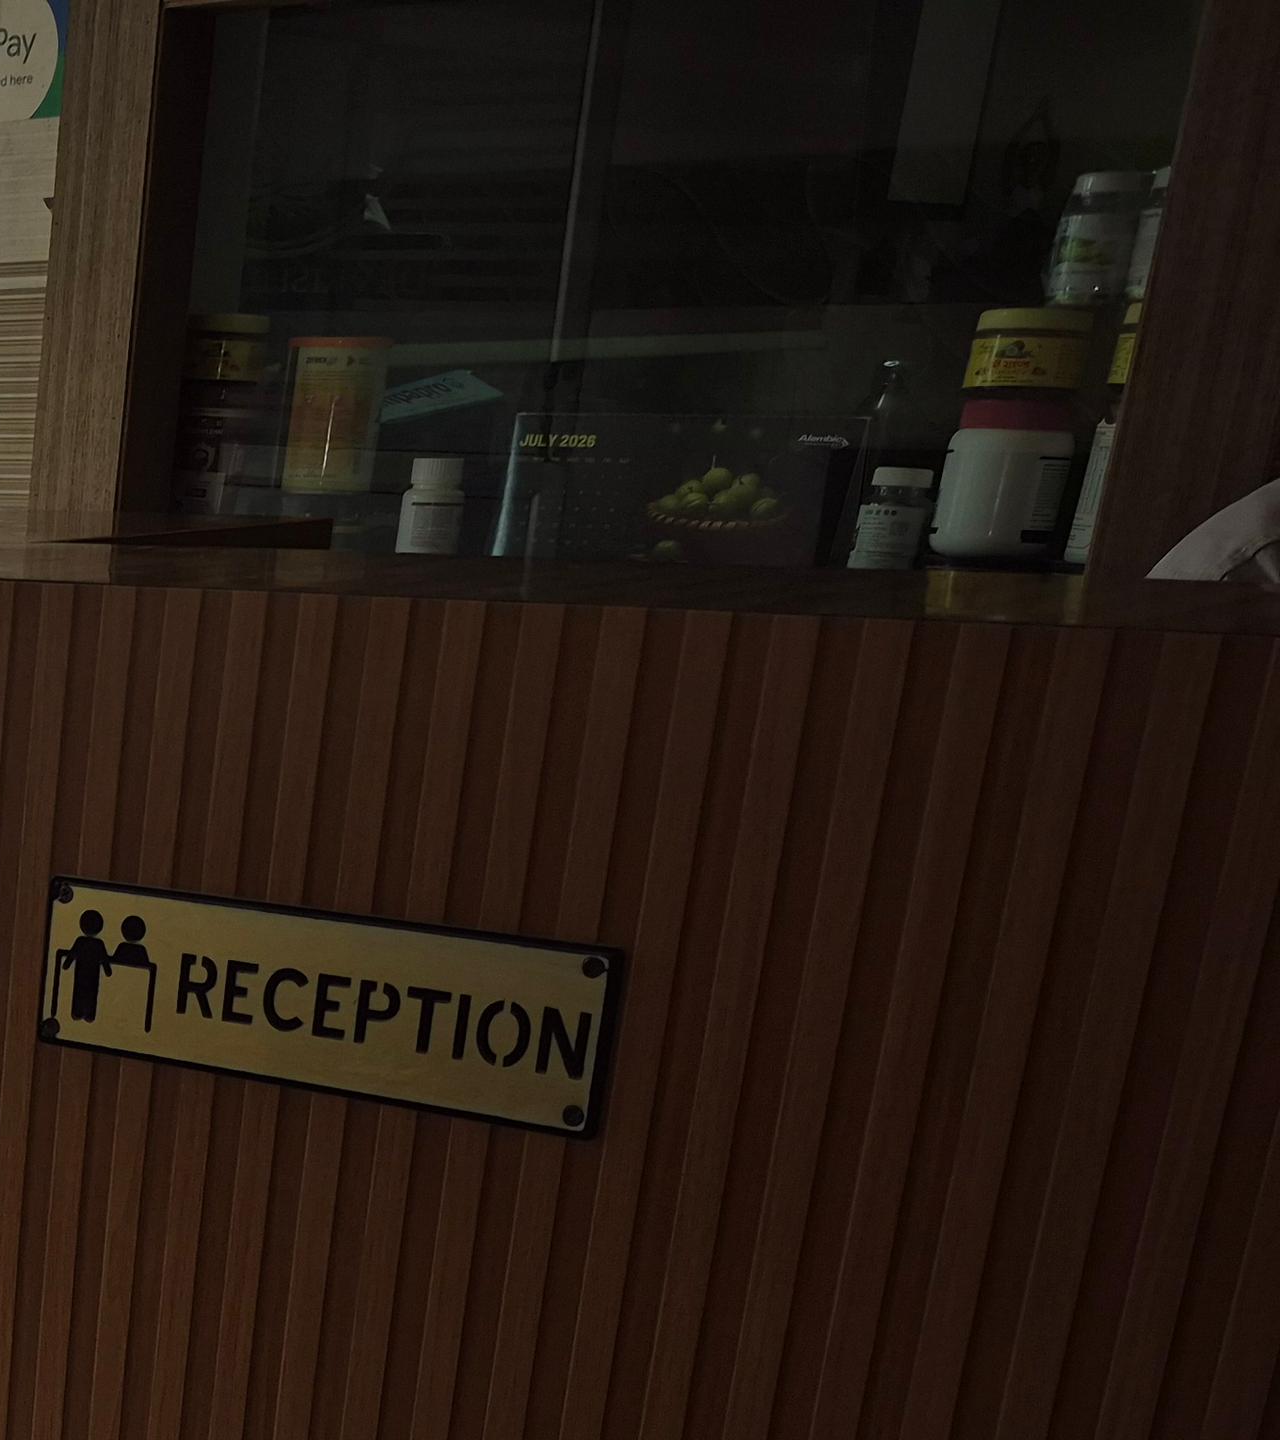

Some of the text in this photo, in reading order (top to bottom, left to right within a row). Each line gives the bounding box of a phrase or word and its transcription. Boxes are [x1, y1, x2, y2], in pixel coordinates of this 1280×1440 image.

[9, 74, 33, 87] here
[519, 433, 597, 448] JULY 2026
[176, 953, 592, 1081] RECEPTION
